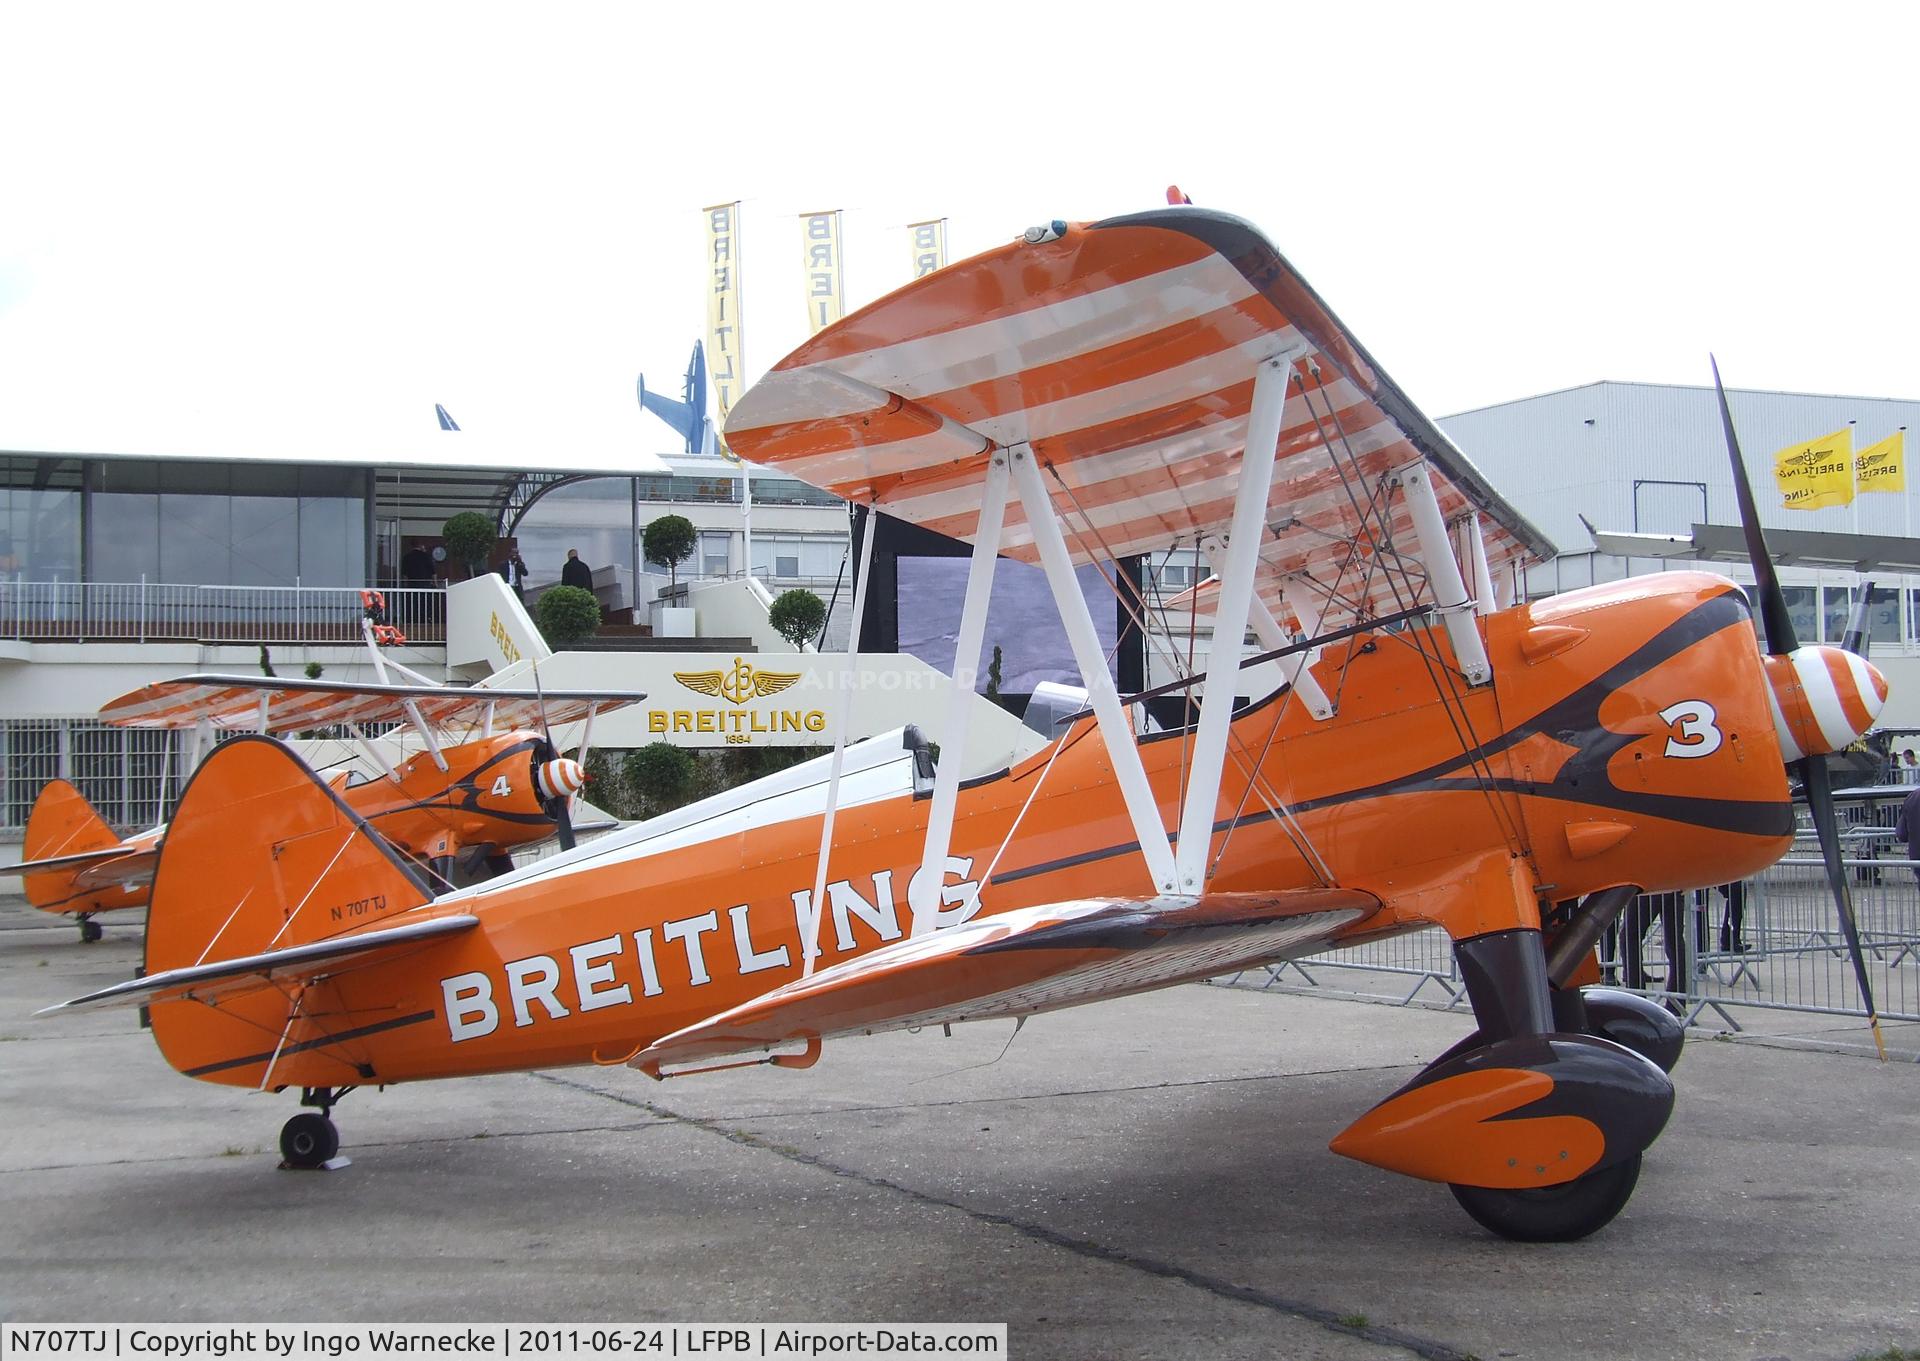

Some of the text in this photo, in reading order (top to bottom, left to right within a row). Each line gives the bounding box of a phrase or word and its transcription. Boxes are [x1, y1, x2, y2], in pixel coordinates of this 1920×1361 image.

[648, 710, 826, 733] BREITLING
[1656, 699, 1723, 758] 3
[491, 775, 512, 797] 4
[440, 855, 983, 1043] BREITLING
